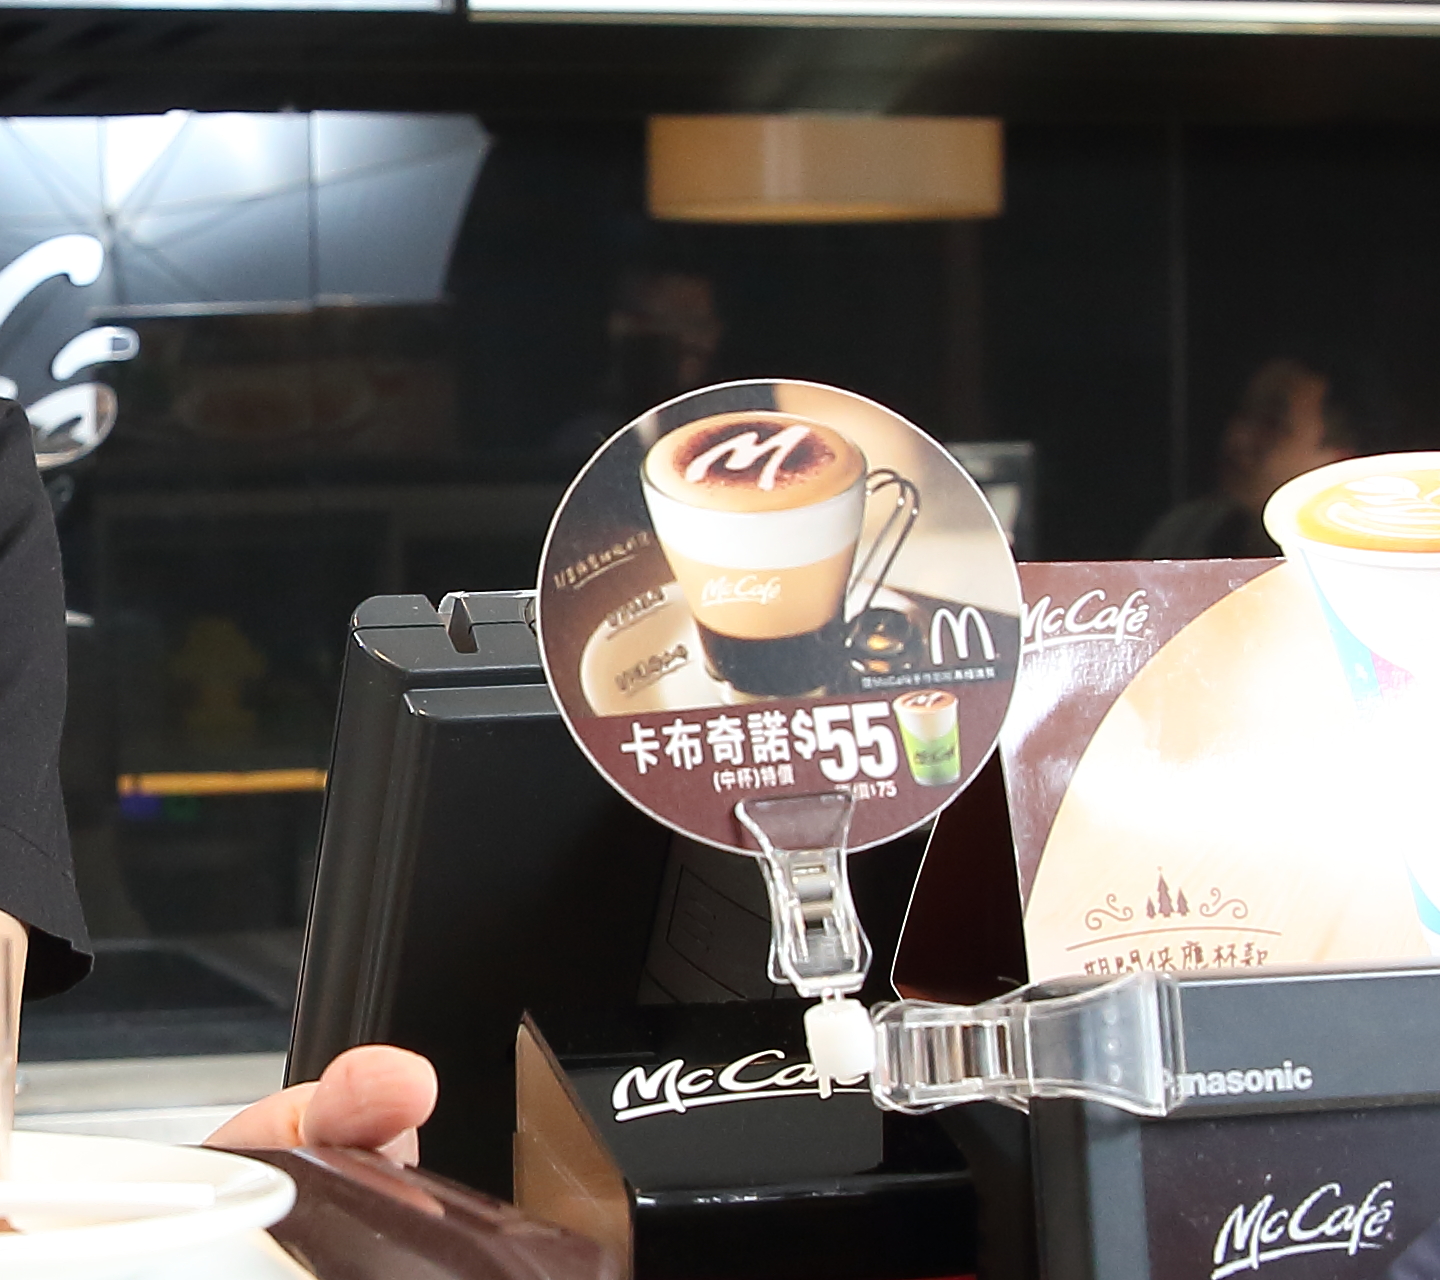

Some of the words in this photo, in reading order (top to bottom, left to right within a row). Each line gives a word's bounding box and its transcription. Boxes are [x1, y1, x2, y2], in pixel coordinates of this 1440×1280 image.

[620, 712, 794, 775] 卡布奇諾
[794, 701, 900, 783] $55
